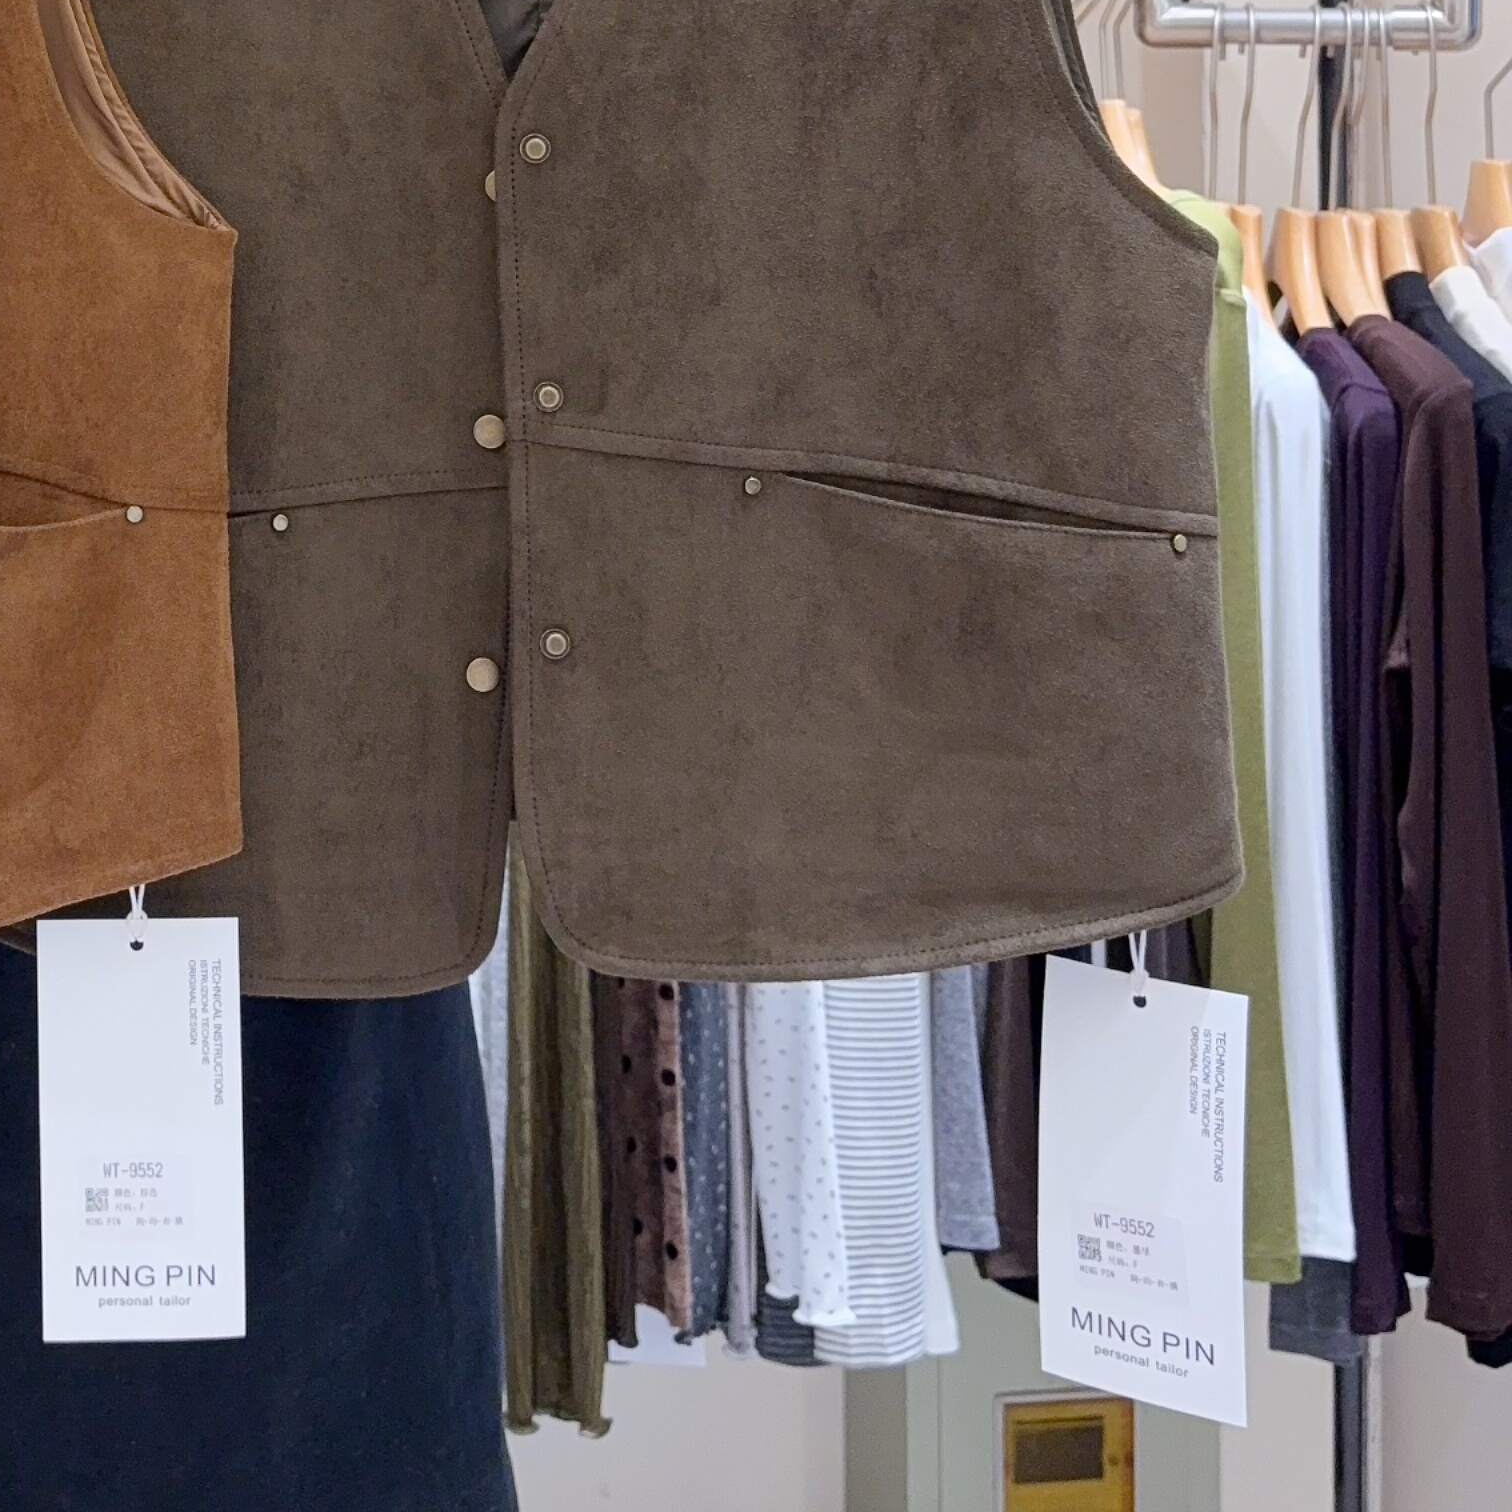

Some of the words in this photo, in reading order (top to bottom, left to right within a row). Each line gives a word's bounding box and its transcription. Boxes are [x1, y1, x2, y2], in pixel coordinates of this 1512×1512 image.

[188, 959, 197, 1007] ORIGINAL
[212, 958, 222, 1021] TECHNICAL
[189, 1007, 198, 1046] DESIGN
[213, 1023, 224, 1106] INSTRUCTIONS
[1190, 1025, 1199, 1073] ORIGINAL
[1215, 1031, 1227, 1094] TECHNICAL
[1189, 1075, 1198, 1115] DESIGN
[1213, 1097, 1225, 1183] INSTRUCTIONS
[102, 1162, 164, 1178] WT-9552
[1093, 1212, 1156, 1238] WT-9552
[75, 1264, 156, 1287] MING
[166, 1264, 216, 1287] PIN
[98, 1296, 154, 1309] personal
[159, 1296, 191, 1307] tailor
[1071, 1306, 1152, 1348] MING
[1162, 1331, 1215, 1366] PIN
[1093, 1345, 1150, 1368] personal
[1155, 1360, 1189, 1378] tailor
